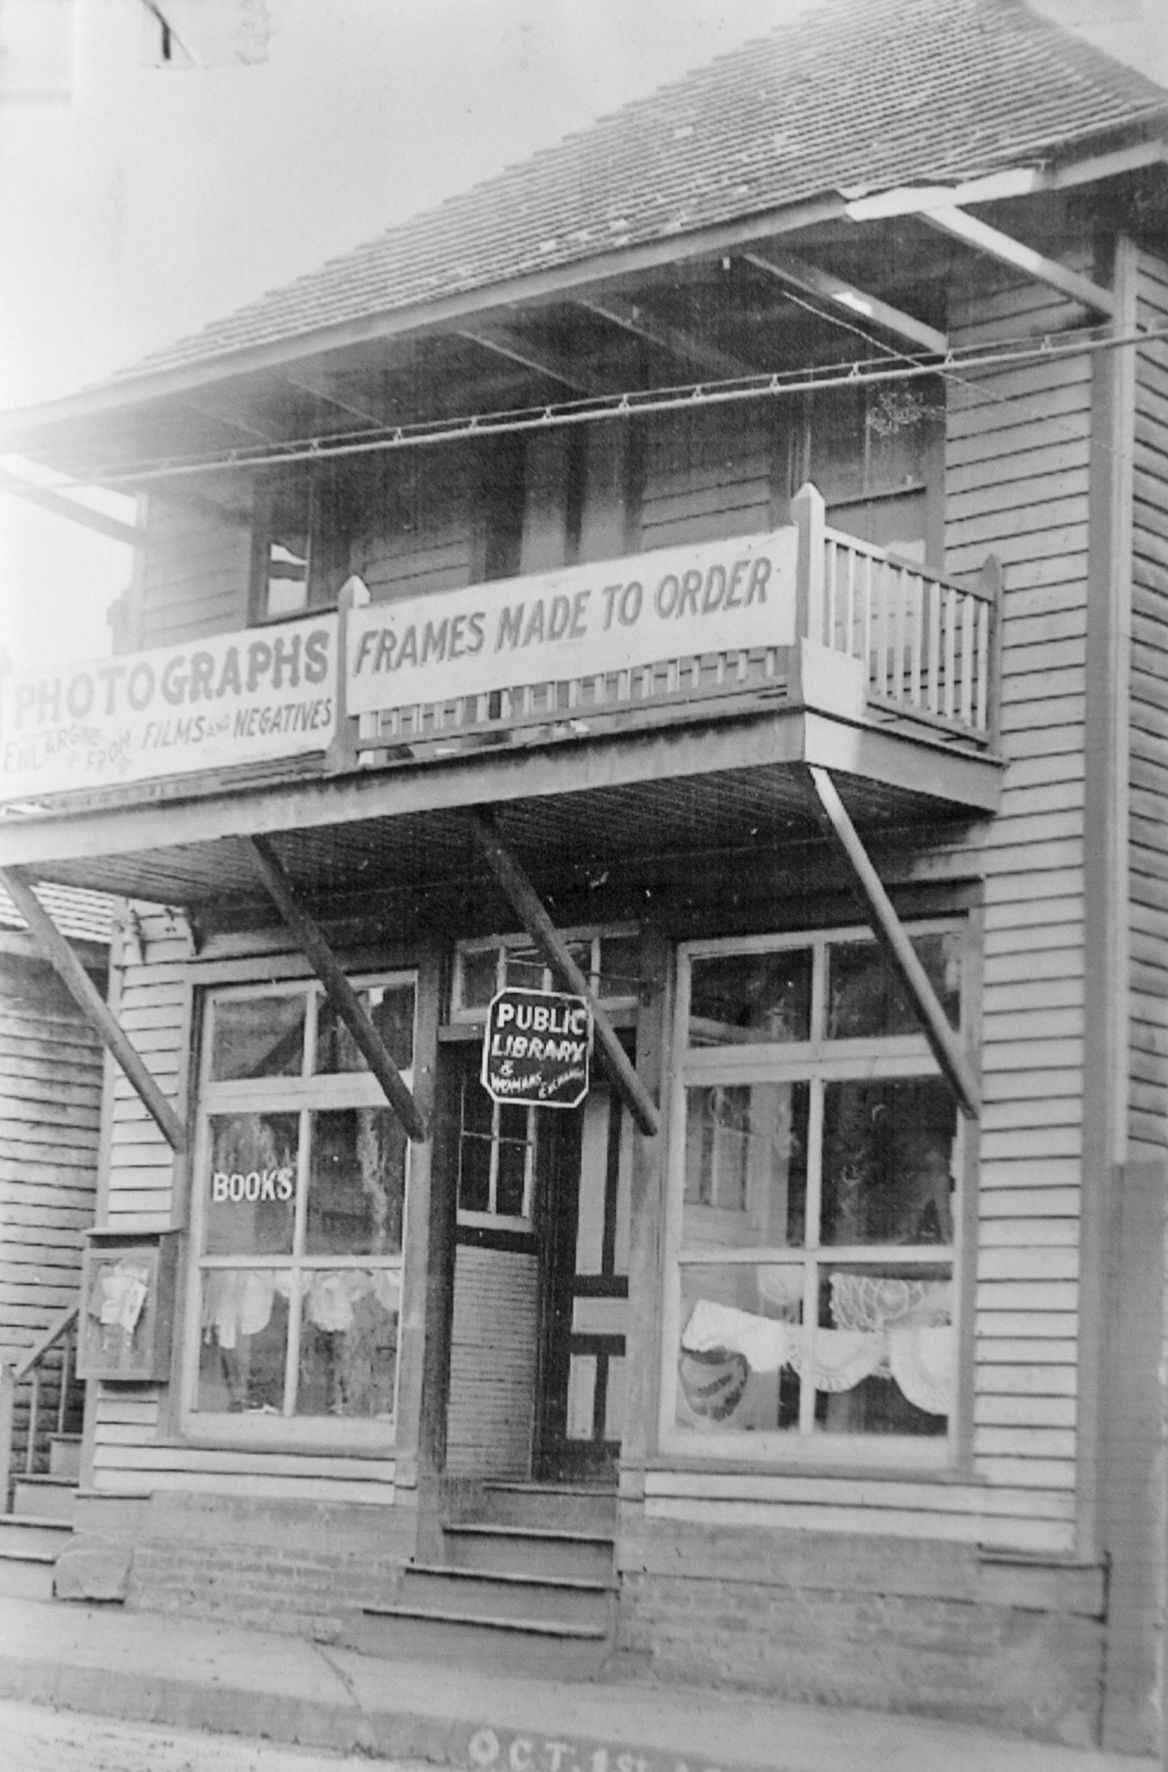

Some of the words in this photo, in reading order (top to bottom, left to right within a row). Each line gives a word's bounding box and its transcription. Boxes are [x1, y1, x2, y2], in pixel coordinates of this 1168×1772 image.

[352, 611, 486, 677] FRAMES
[493, 590, 592, 654] MADE
[602, 580, 644, 632] TO
[653, 556, 772, 620] ORDER
[13, 629, 330, 731] PHOTOGRAPHS
[142, 715, 206, 749] FILMS
[232, 698, 333, 740] NEGATIVES
[497, 1003, 587, 1035] PUBLIC
[491, 1034, 585, 1063] LIBRARY
[212, 1167, 294, 1202] BOOKS
